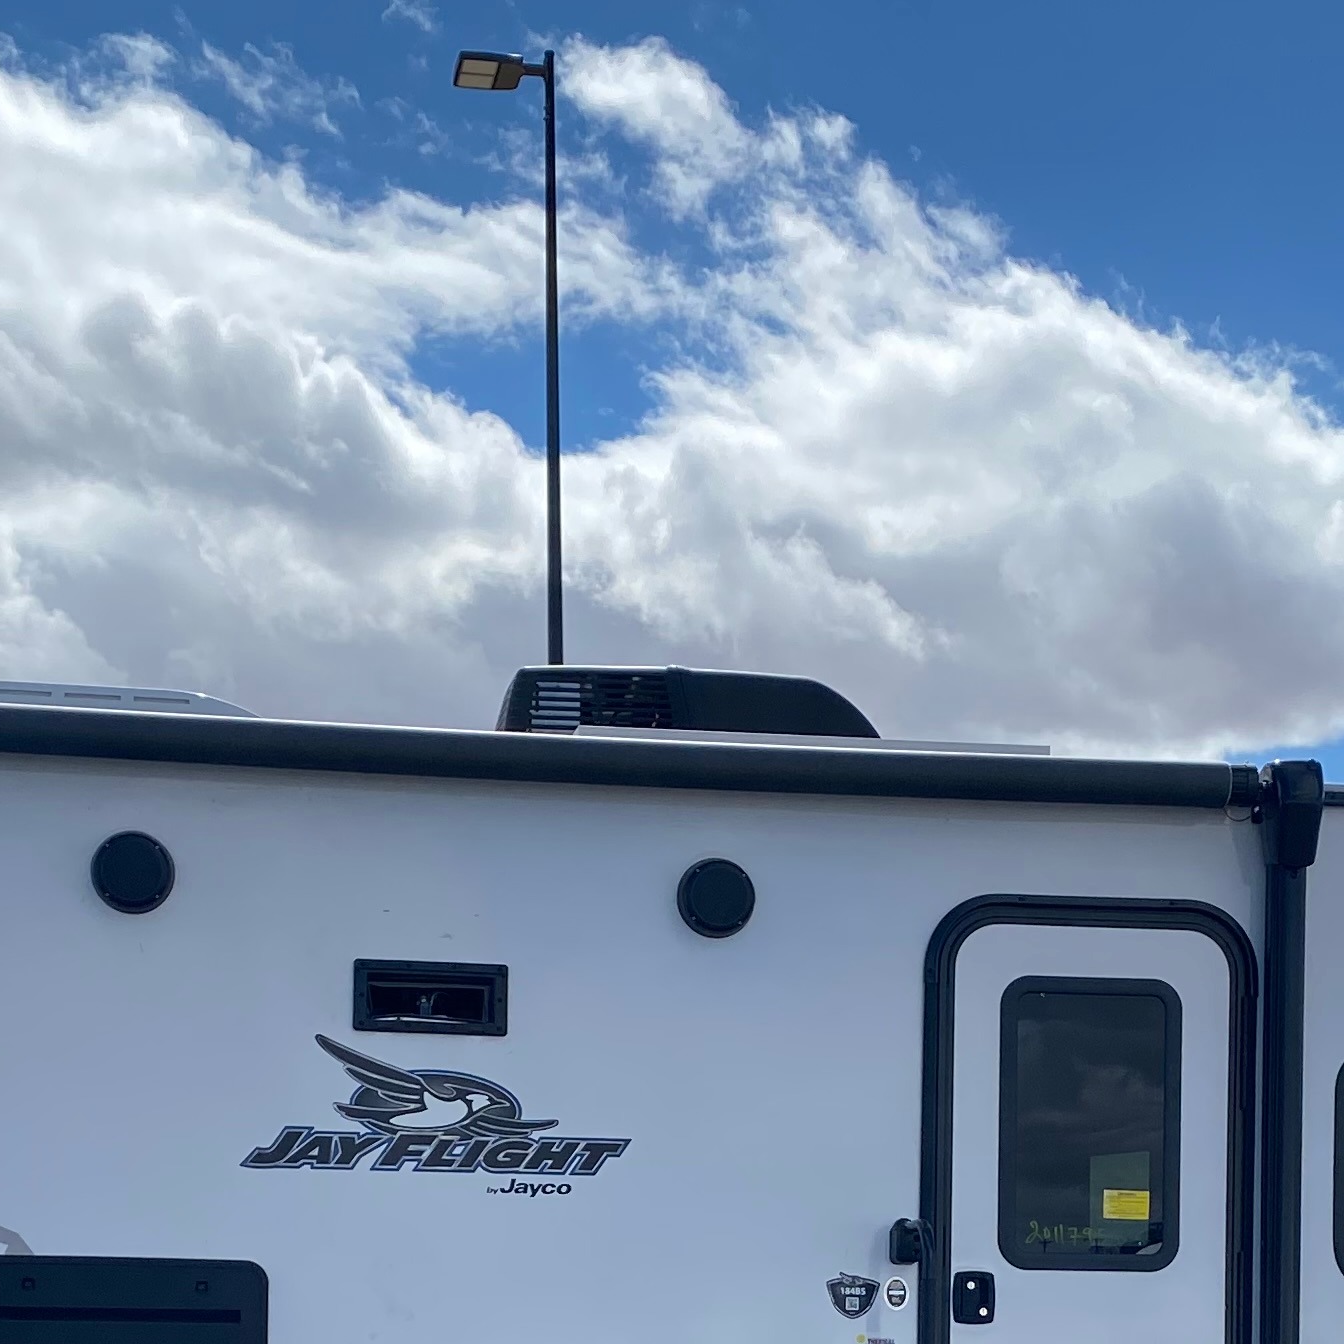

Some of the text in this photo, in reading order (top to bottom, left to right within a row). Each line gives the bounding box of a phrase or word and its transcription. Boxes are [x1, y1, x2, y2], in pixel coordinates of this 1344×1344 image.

[239, 1125, 632, 1176] JAY FLIGHT
[486, 1178, 572, 1198] by Jayco
